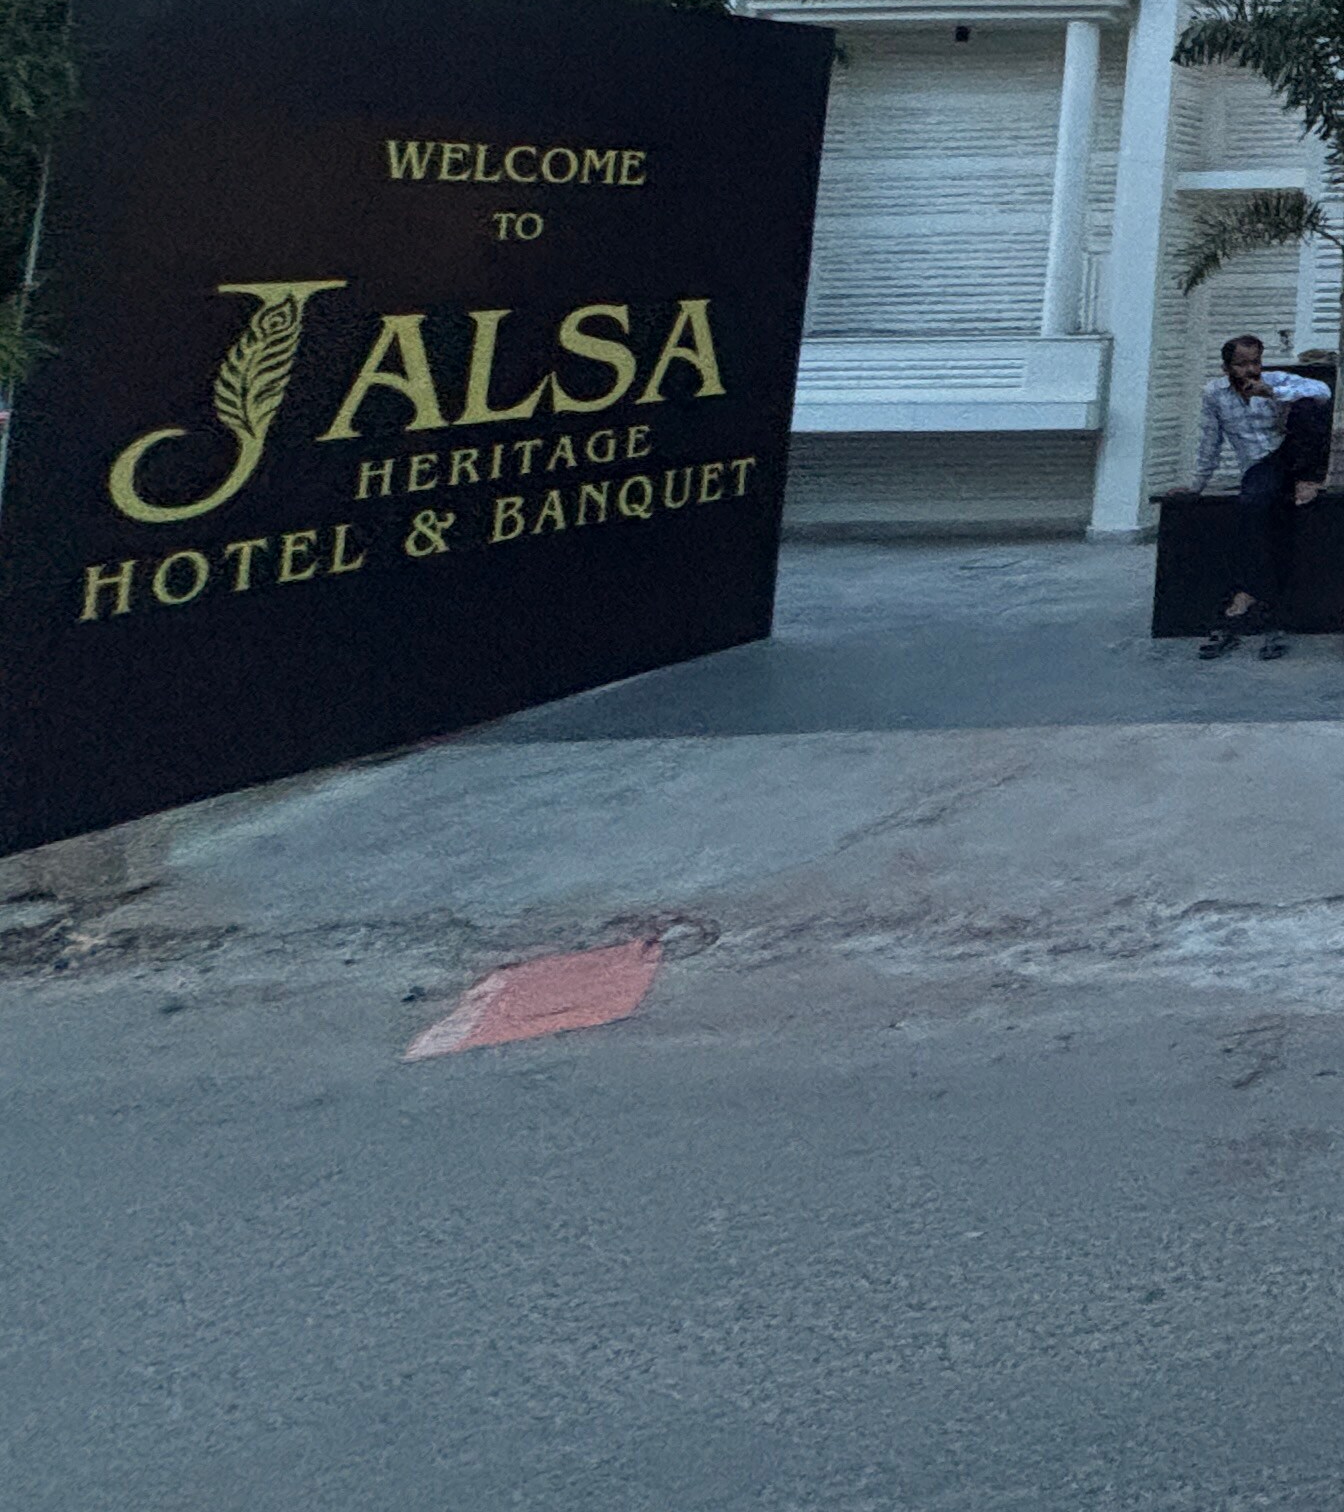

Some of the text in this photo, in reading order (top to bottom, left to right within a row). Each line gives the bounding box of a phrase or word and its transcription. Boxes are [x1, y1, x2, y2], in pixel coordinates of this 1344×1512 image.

[386, 139, 647, 186] WELCOME
[492, 211, 544, 241] TO
[108, 279, 727, 524] JALSA
[355, 424, 653, 500] HERITAGE
[78, 457, 757, 623] HOTEL & BANQUET
